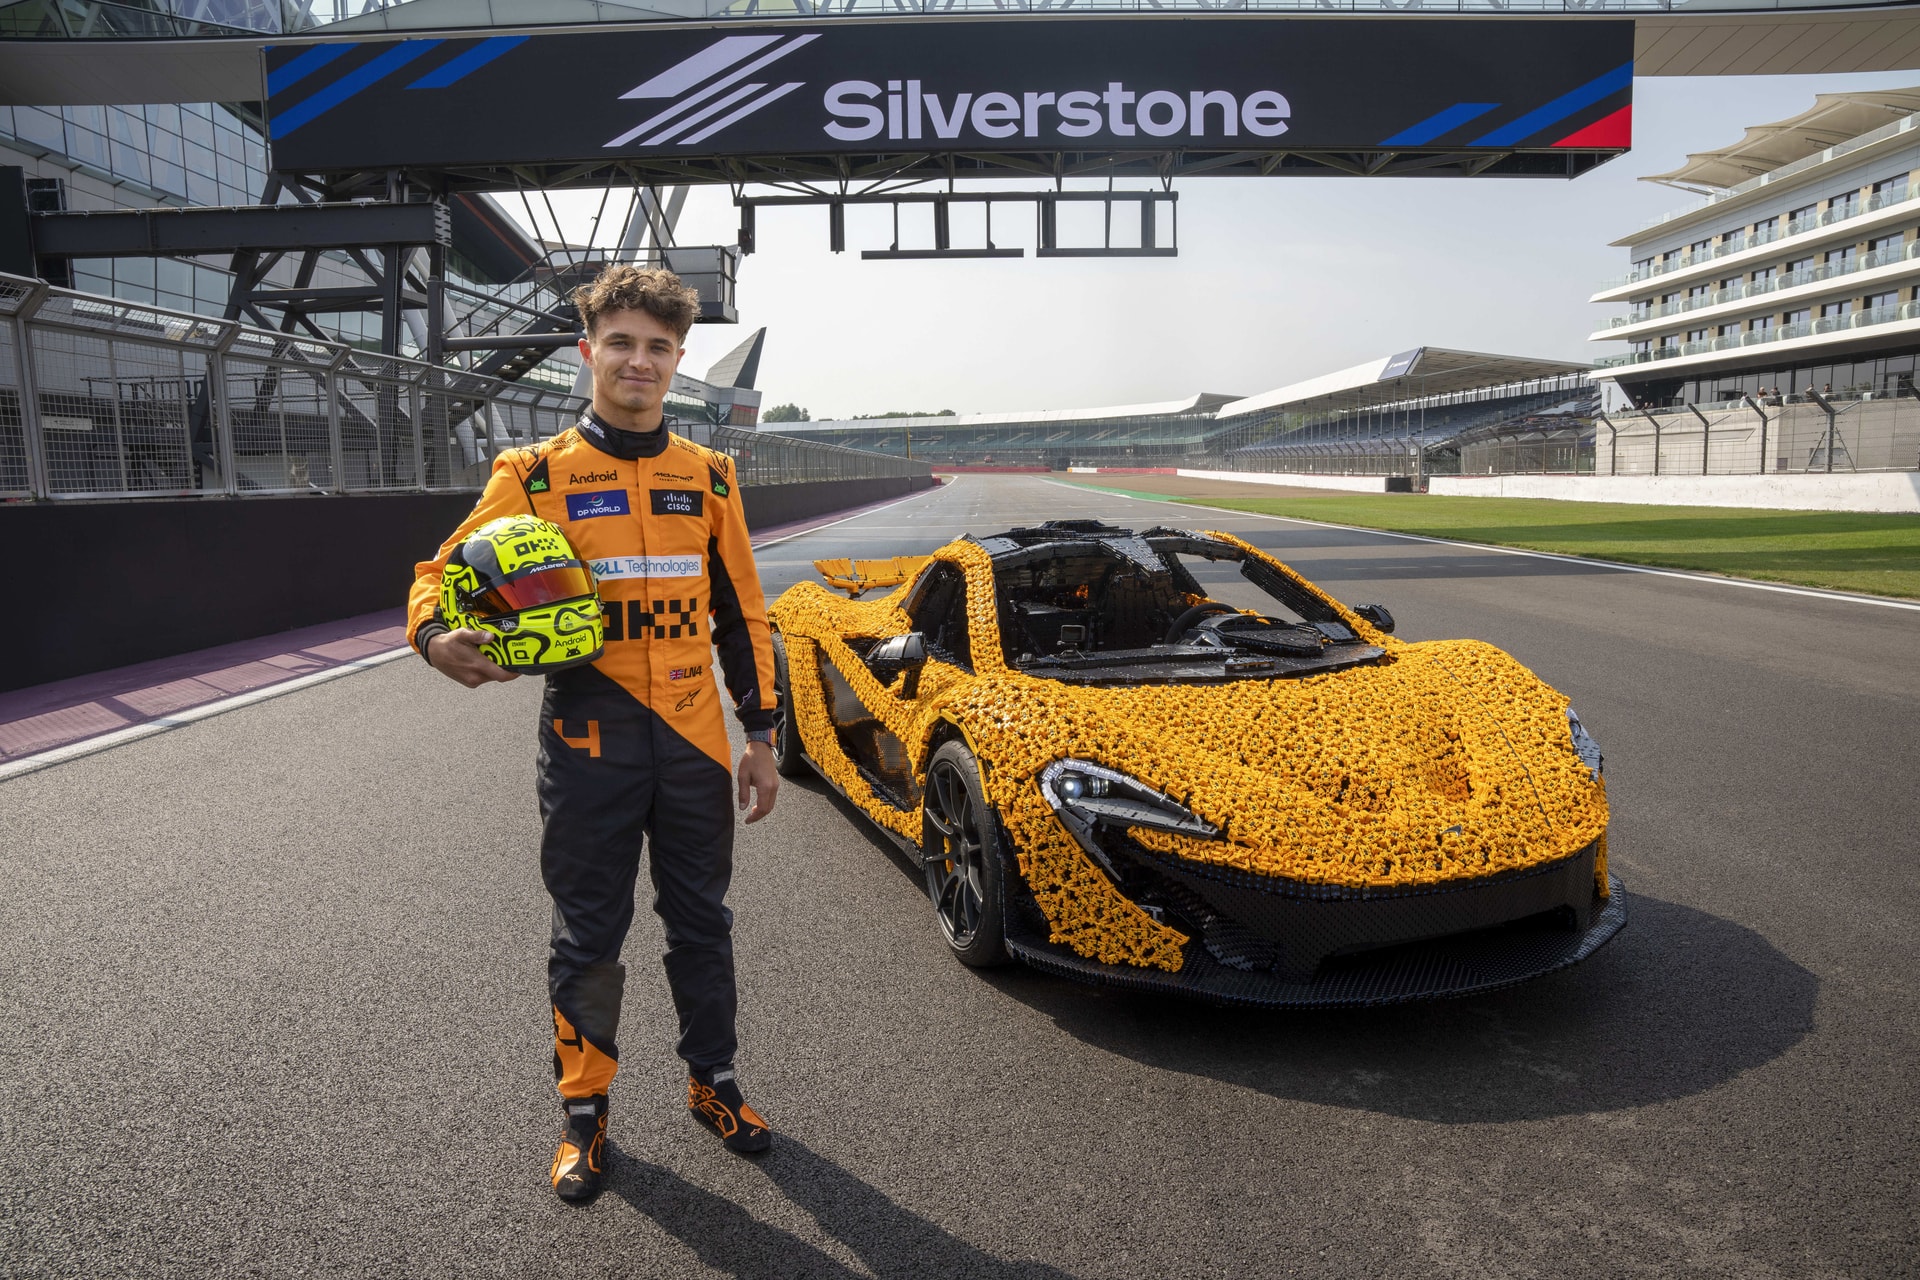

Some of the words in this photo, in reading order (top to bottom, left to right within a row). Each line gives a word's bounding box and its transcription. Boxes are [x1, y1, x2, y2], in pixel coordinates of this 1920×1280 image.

[823, 79, 1291, 141] Silverstone
[569, 470, 618, 485] Android
[590, 505, 621, 514] WORLD
[667, 503, 691, 512] CISCO
[513, 538, 559, 557] OKX
[529, 562, 566, 574] McLaren
[591, 561, 624, 576] ELL
[625, 558, 699, 576] Technologies
[554, 633, 587, 648] Android
[683, 665, 703, 679] LN4
[553, 719, 601, 758] 4
